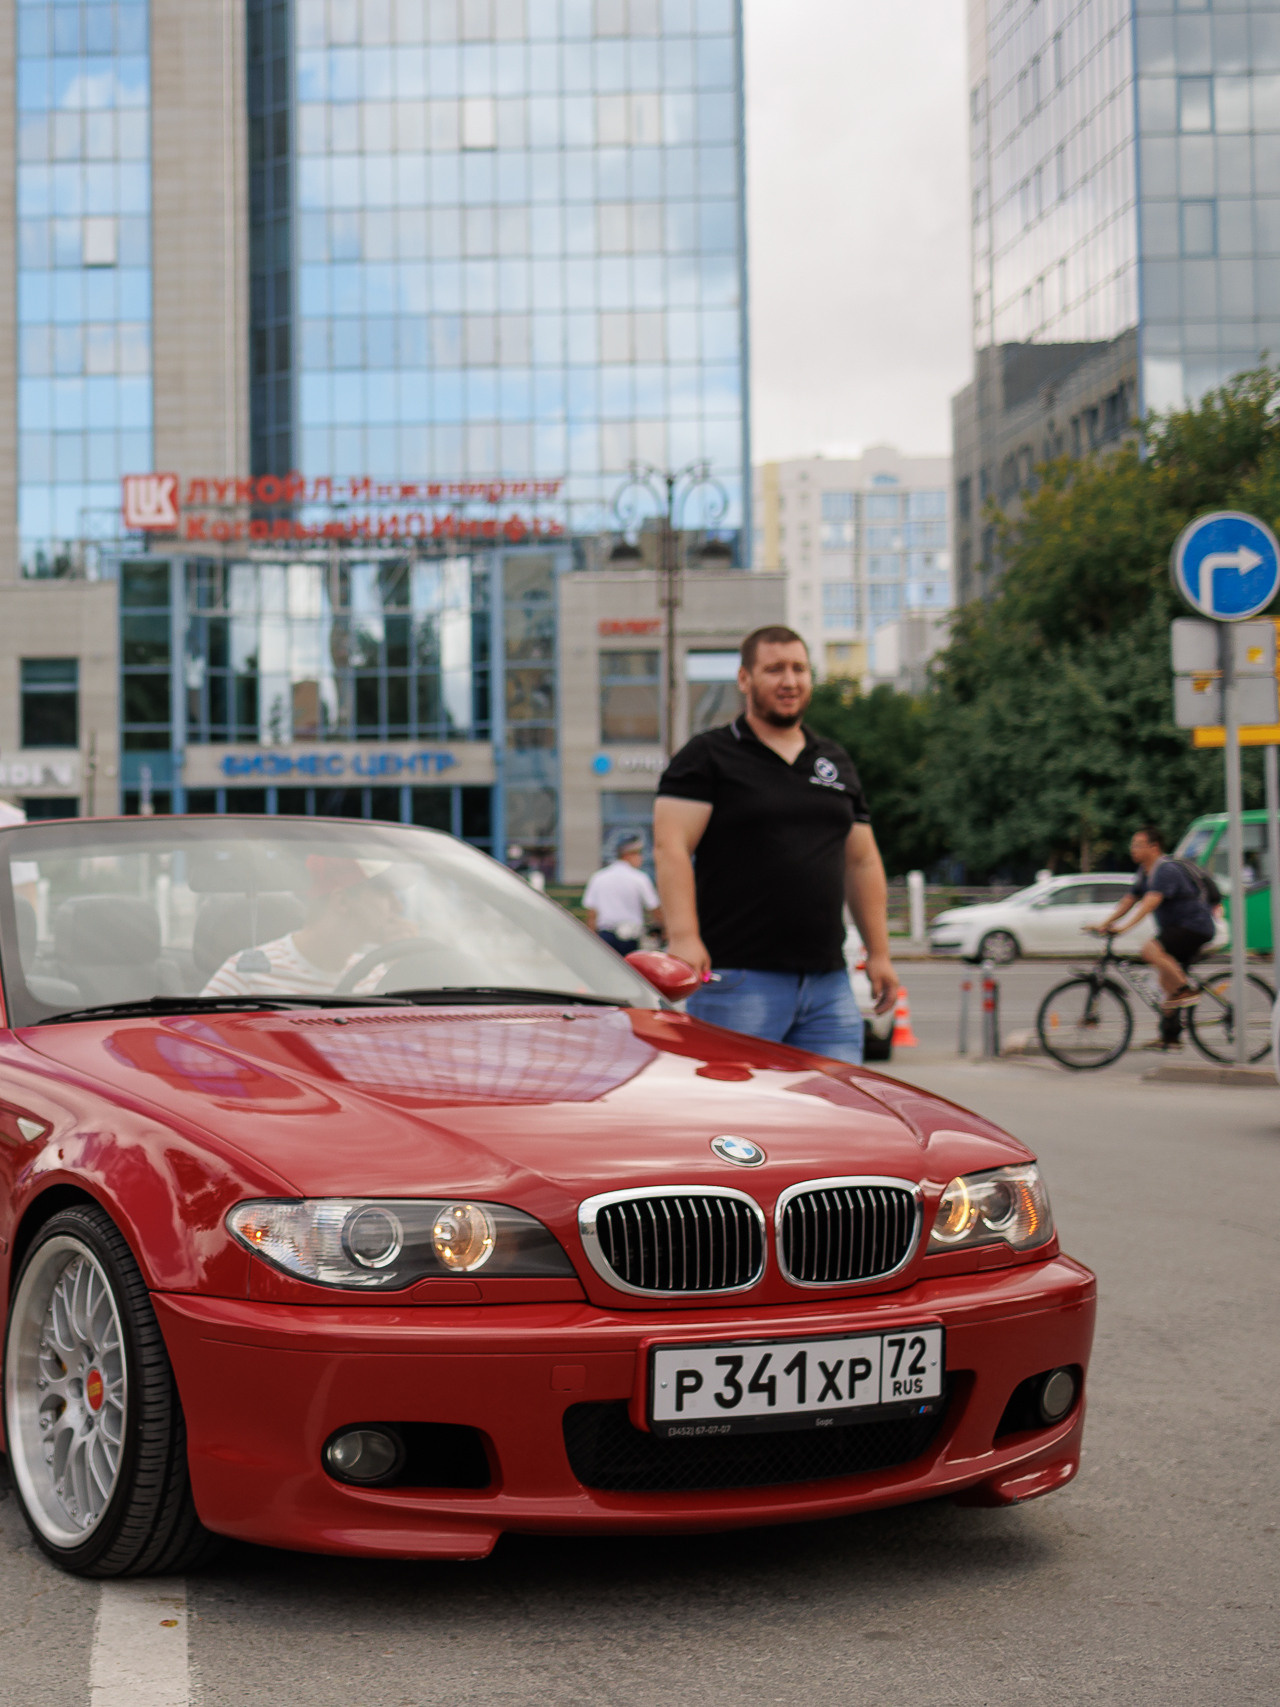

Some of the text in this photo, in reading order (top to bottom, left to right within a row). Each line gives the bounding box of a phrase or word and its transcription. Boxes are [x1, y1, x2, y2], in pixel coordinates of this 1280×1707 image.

[222, 751, 457, 777] БИЗНЕС ЦЕНТР
[887, 1336, 926, 1378] 72
[892, 1379, 923, 1397] RUS
